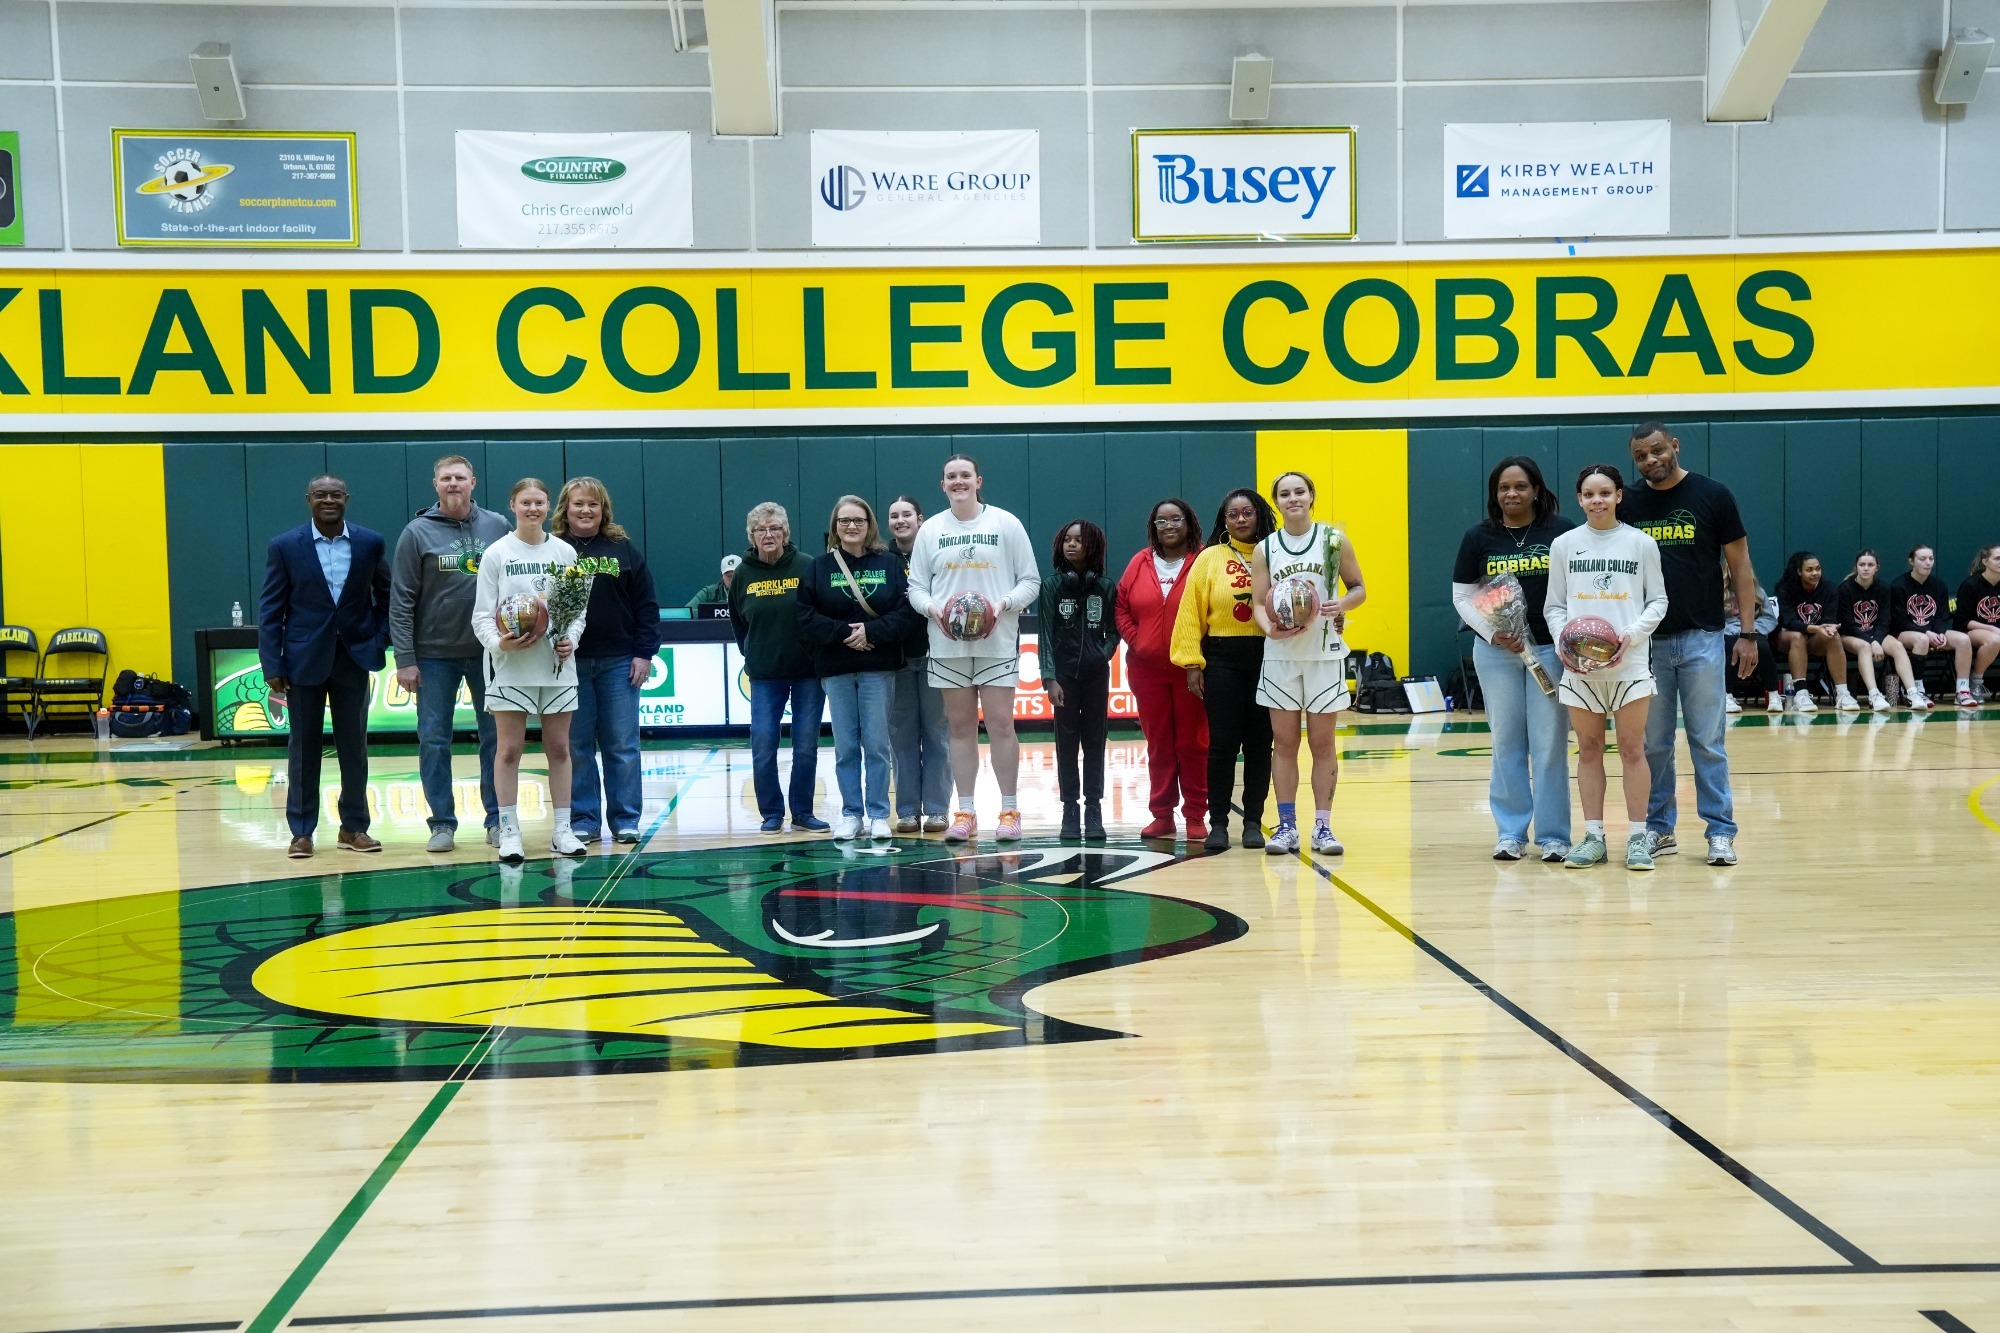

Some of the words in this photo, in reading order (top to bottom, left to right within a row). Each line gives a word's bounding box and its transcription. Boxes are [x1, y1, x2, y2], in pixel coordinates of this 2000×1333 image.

[154, 148, 201, 174] SOCCER
[279, 154, 295, 162] 2310
[303, 154, 325, 162] Willow
[326, 154, 335, 162] Rd
[283, 163, 308, 172] Urbana,
[534, 160, 613, 174] COUNTRY
[1501, 163, 1561, 178] KIRBY
[1570, 161, 1654, 177] WEALTH
[1152, 154, 1337, 220] Busey
[1501, 186, 1599, 197] MANAGEMENT
[1606, 185, 1654, 195] GROUP
[168, 190, 215, 214] PLANET
[239, 197, 337, 209] soccerplanetcu.com
[877, 193, 943, 202] GENERAL
[953, 192, 1026, 202] AGENCIES
[521, 203, 557, 216] Chris
[559, 203, 634, 217] Greenwold
[160, 222, 244, 233] State-of-the-art
[246, 223, 280, 233] indoor
[282, 223, 317, 235] facility
[538, 223, 619, 235] 217.355.8675
[0, 287, 441, 396] LAND
[495, 281, 1172, 395] COLLEGE
[1222, 269, 1815, 386] COBRAS
[1641, 524, 1695, 541] OBRAS
[939, 534, 971, 550] PARKLAND
[972, 533, 999, 547] COLLEGE
[1487, 553, 1524, 562] PARKLAND
[505, 562, 541, 577] PARKLAND
[1273, 562, 1324, 582] PARKLAN
[1486, 555, 1550, 576] COBRAS
[1569, 559, 1606, 574] PARKLAND
[1607, 559, 1639, 576] COLLEGE
[756, 578, 800, 591] PARKLAND
[0, 628, 29, 644] KLAND
[56, 631, 99, 646] PARKLAND
